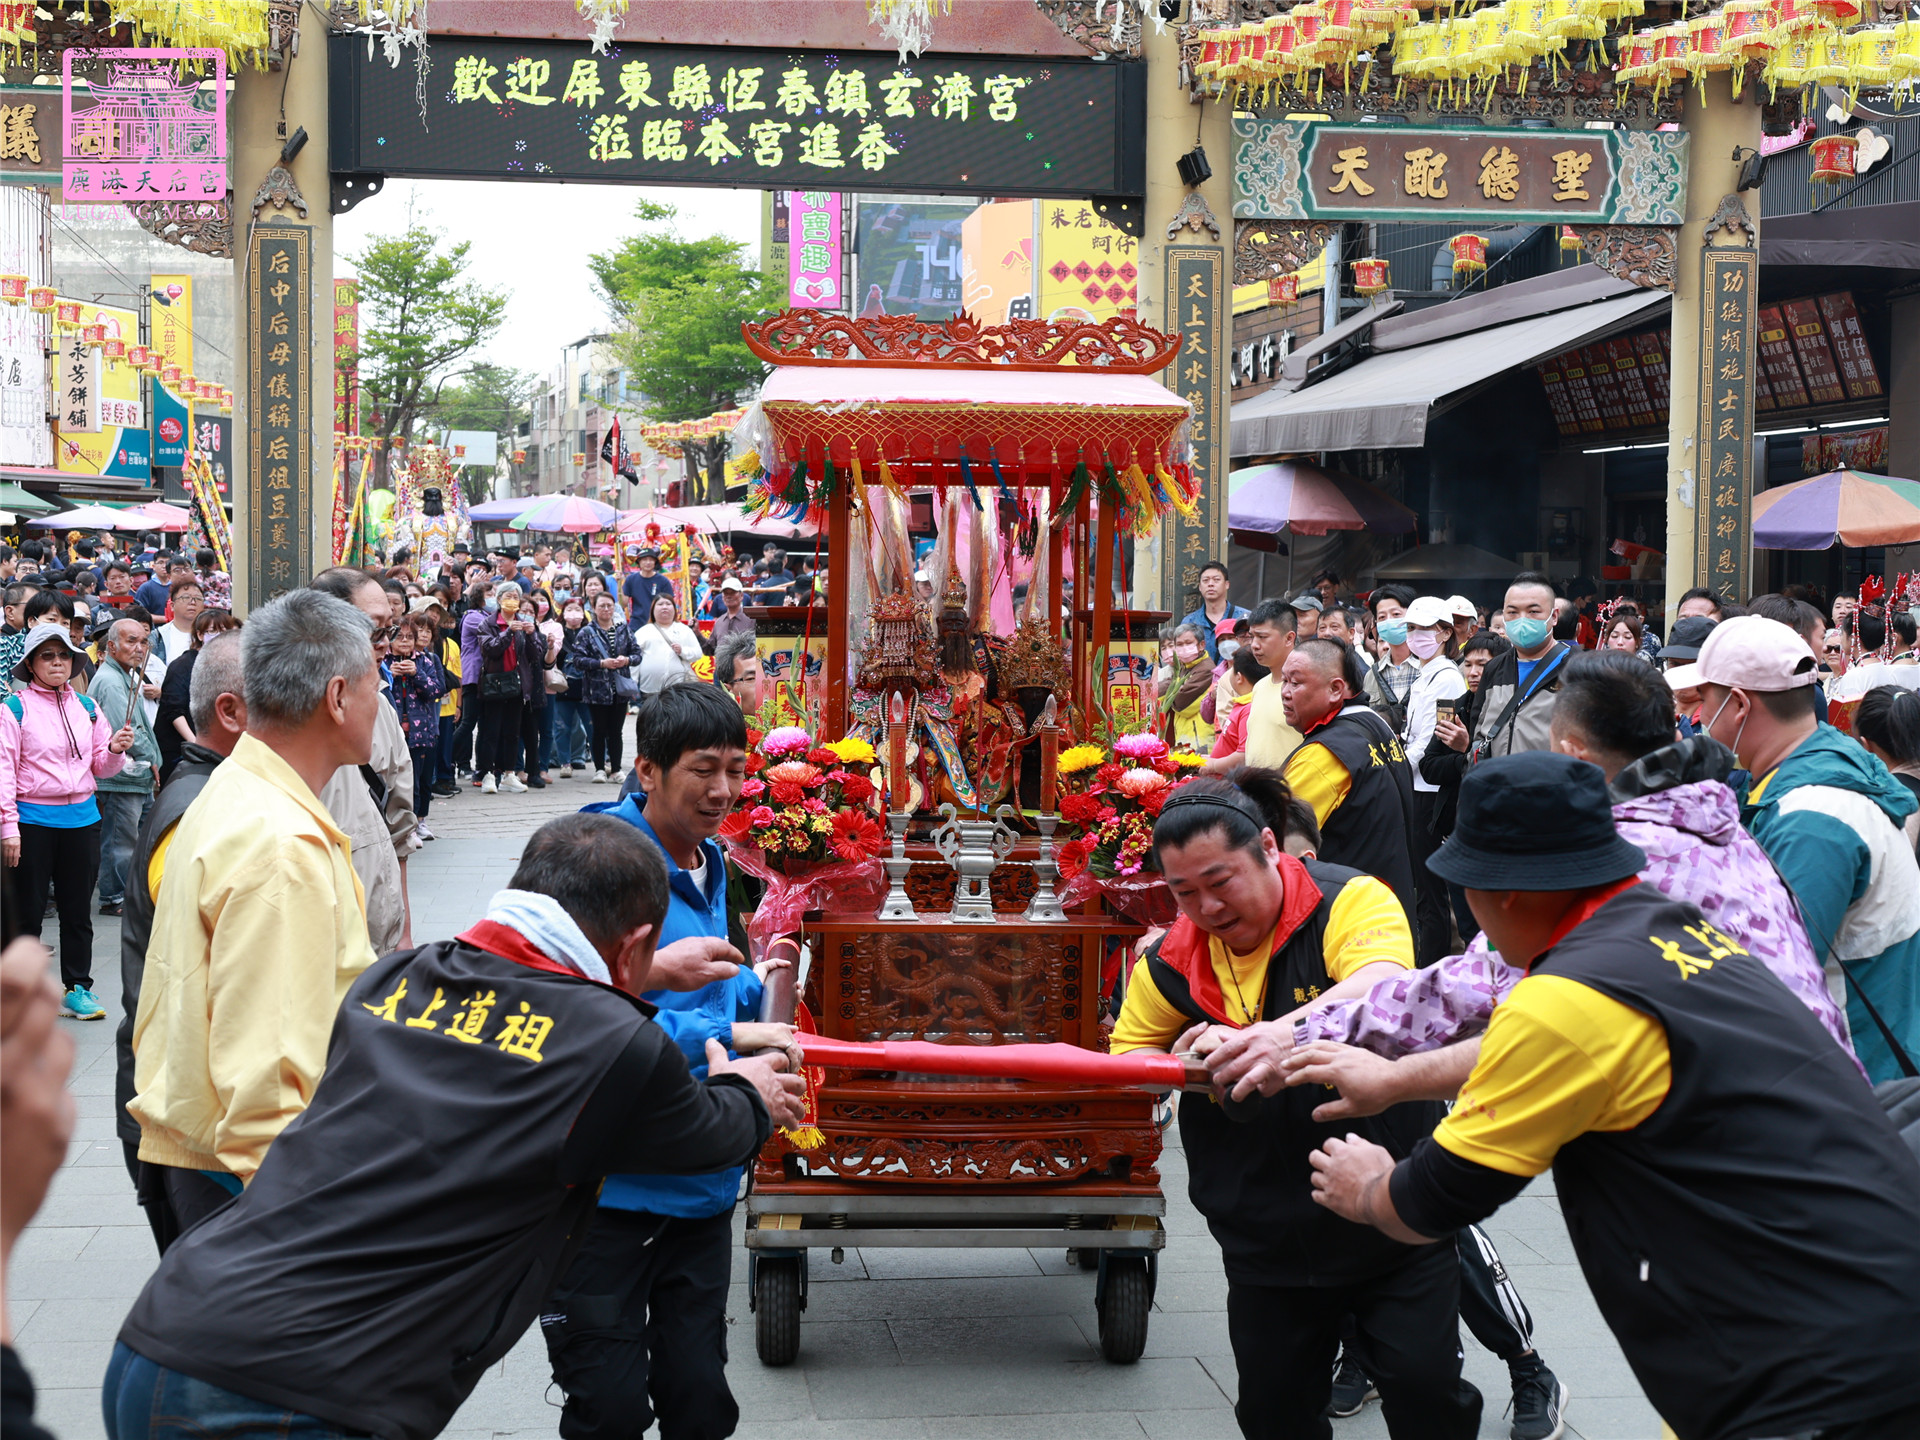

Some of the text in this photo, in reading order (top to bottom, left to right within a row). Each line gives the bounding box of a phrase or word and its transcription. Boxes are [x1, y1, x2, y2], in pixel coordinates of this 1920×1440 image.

[452, 56, 1025, 122] 歡迎屏東縣恆春鎮玄濟宮
[588, 114, 901, 172] 蒞臨本宮進香
[0, 356, 21, 387] 店
